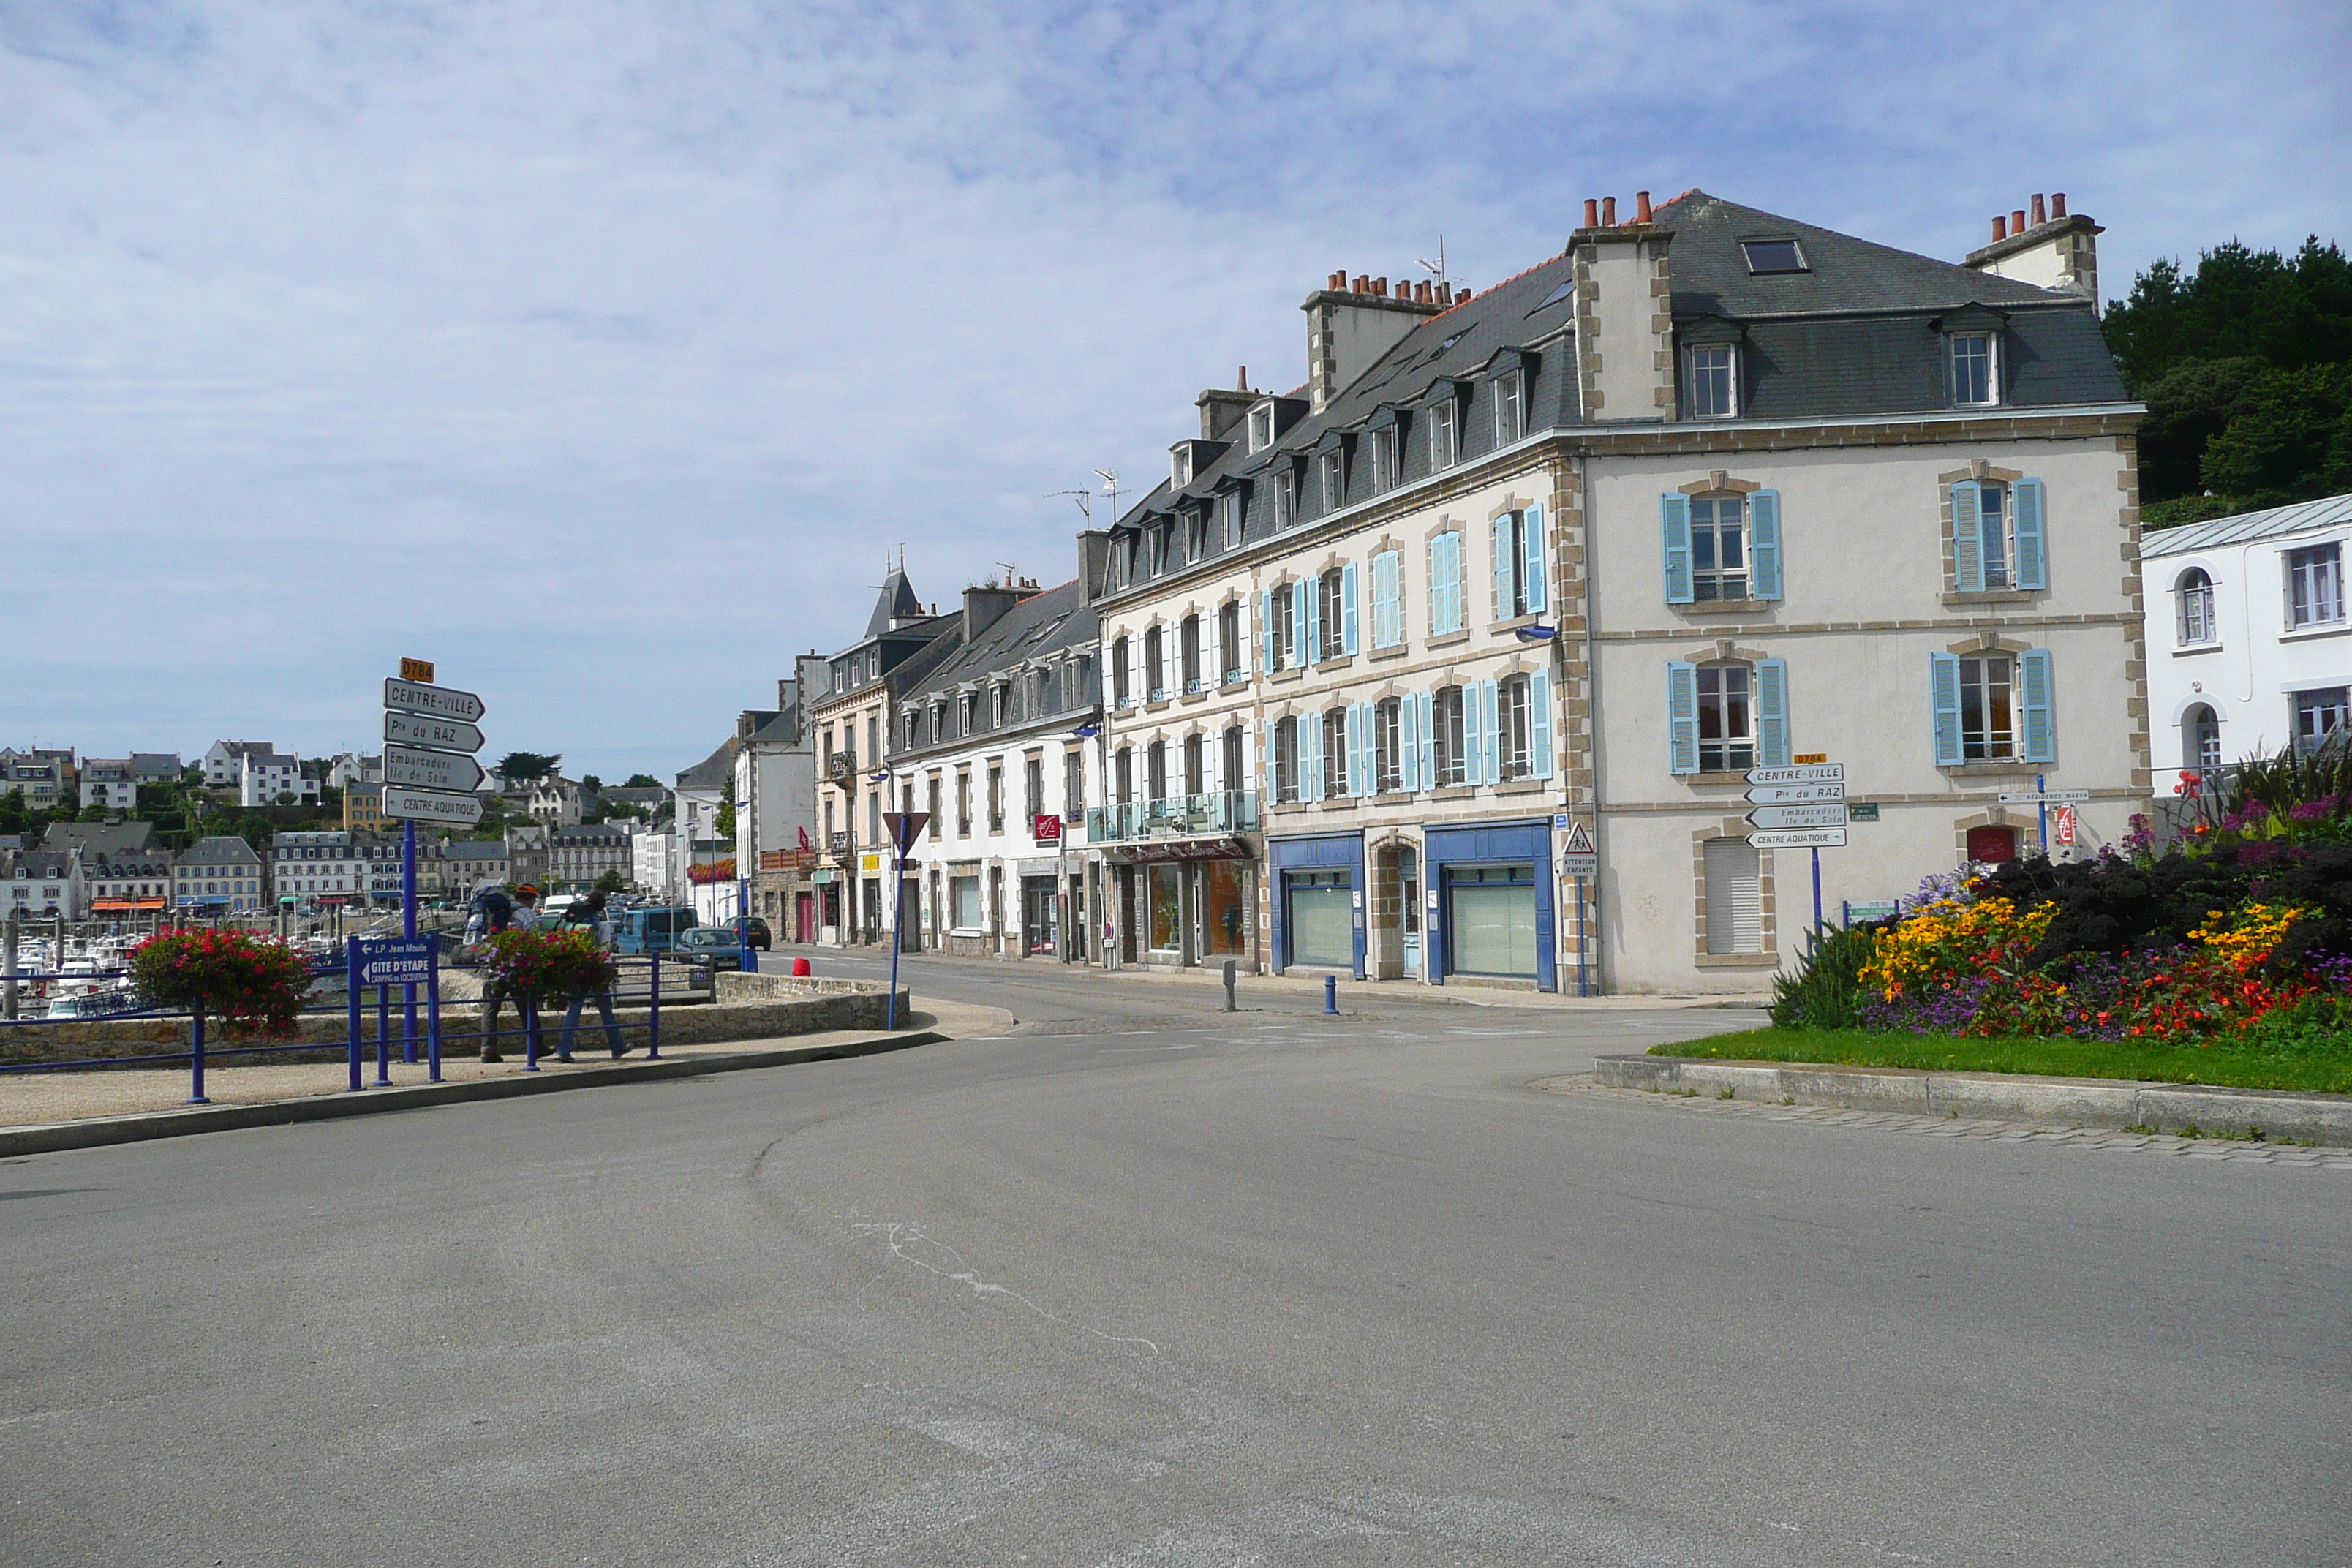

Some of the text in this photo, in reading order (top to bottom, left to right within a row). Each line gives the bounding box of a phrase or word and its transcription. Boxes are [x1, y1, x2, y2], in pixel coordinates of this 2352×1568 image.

[403, 661, 433, 679] D784
[391, 687, 473, 715] CENTRE-VILLE
[391, 720, 456, 742] Pte du RAZ
[1798, 754, 1822, 763] D784
[410, 769, 421, 781] de
[427, 771, 448, 784] Sein
[1757, 767, 1839, 781] CENTRE-VILLE
[1776, 787, 1840, 799] Pte du RAZ
[404, 798, 475, 816] CENTRE AQUATIQUE
[1804, 815, 1814, 824] de
[1822, 814, 1842, 824] Sein
[1757, 834, 1829, 844] CENTRE AQUATIQUE
[388, 944, 404, 953] Jean
[405, 943, 427, 953] Moulin
[371, 960, 429, 973] GITE D'ETAPE
[371, 974, 393, 983] CAMPING
